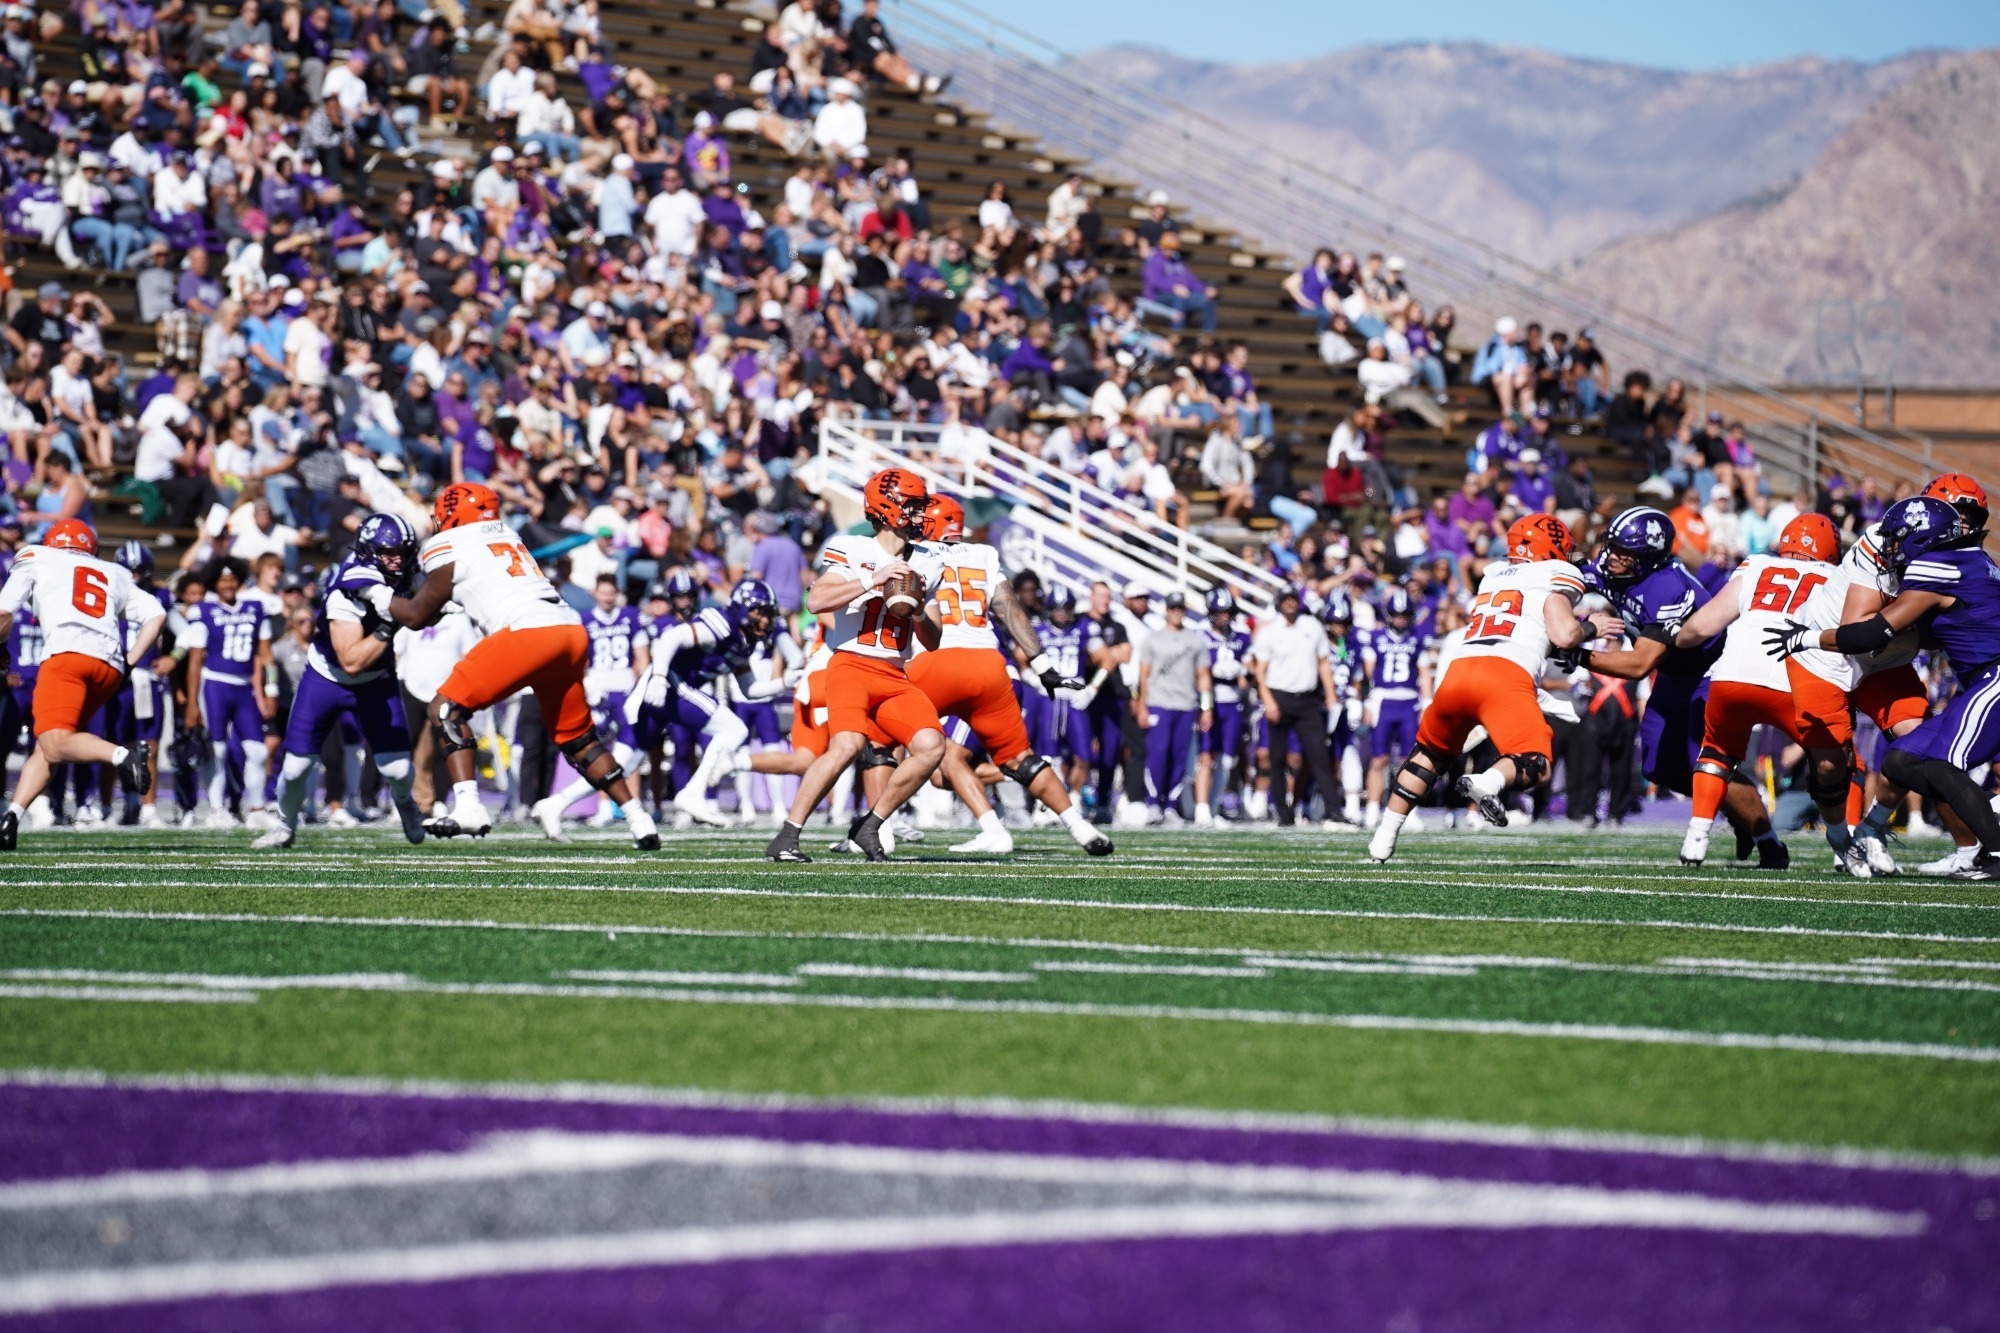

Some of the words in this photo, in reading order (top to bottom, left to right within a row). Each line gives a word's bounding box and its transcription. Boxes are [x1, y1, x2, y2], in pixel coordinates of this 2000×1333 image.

[72, 565, 109, 619] 6
[935, 566, 988, 627] 65
[1463, 590, 1524, 640] 52
[857, 596, 911, 651] 16
